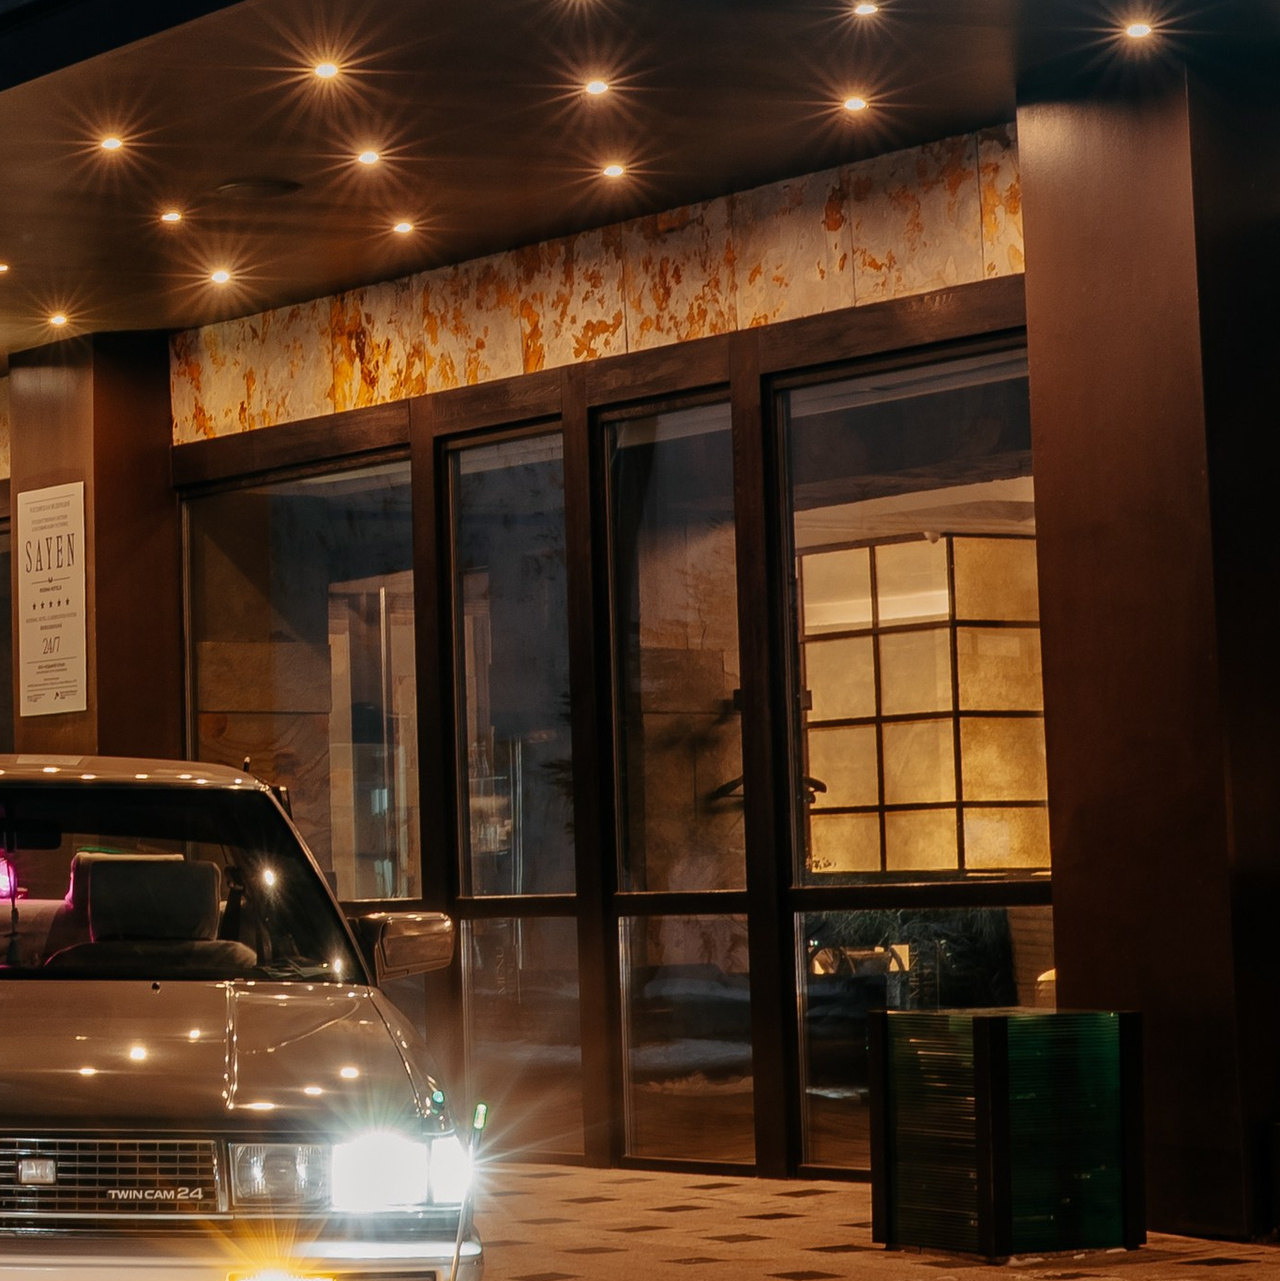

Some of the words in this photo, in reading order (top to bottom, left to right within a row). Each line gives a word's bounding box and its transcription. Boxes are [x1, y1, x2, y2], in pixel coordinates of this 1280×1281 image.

[25, 532, 75, 573] SAYEN
[42, 636, 61, 655] 24/7
[107, 1189, 143, 1200] TWIN
[144, 1189, 175, 1200] CAM
[176, 1186, 204, 1200] 24
